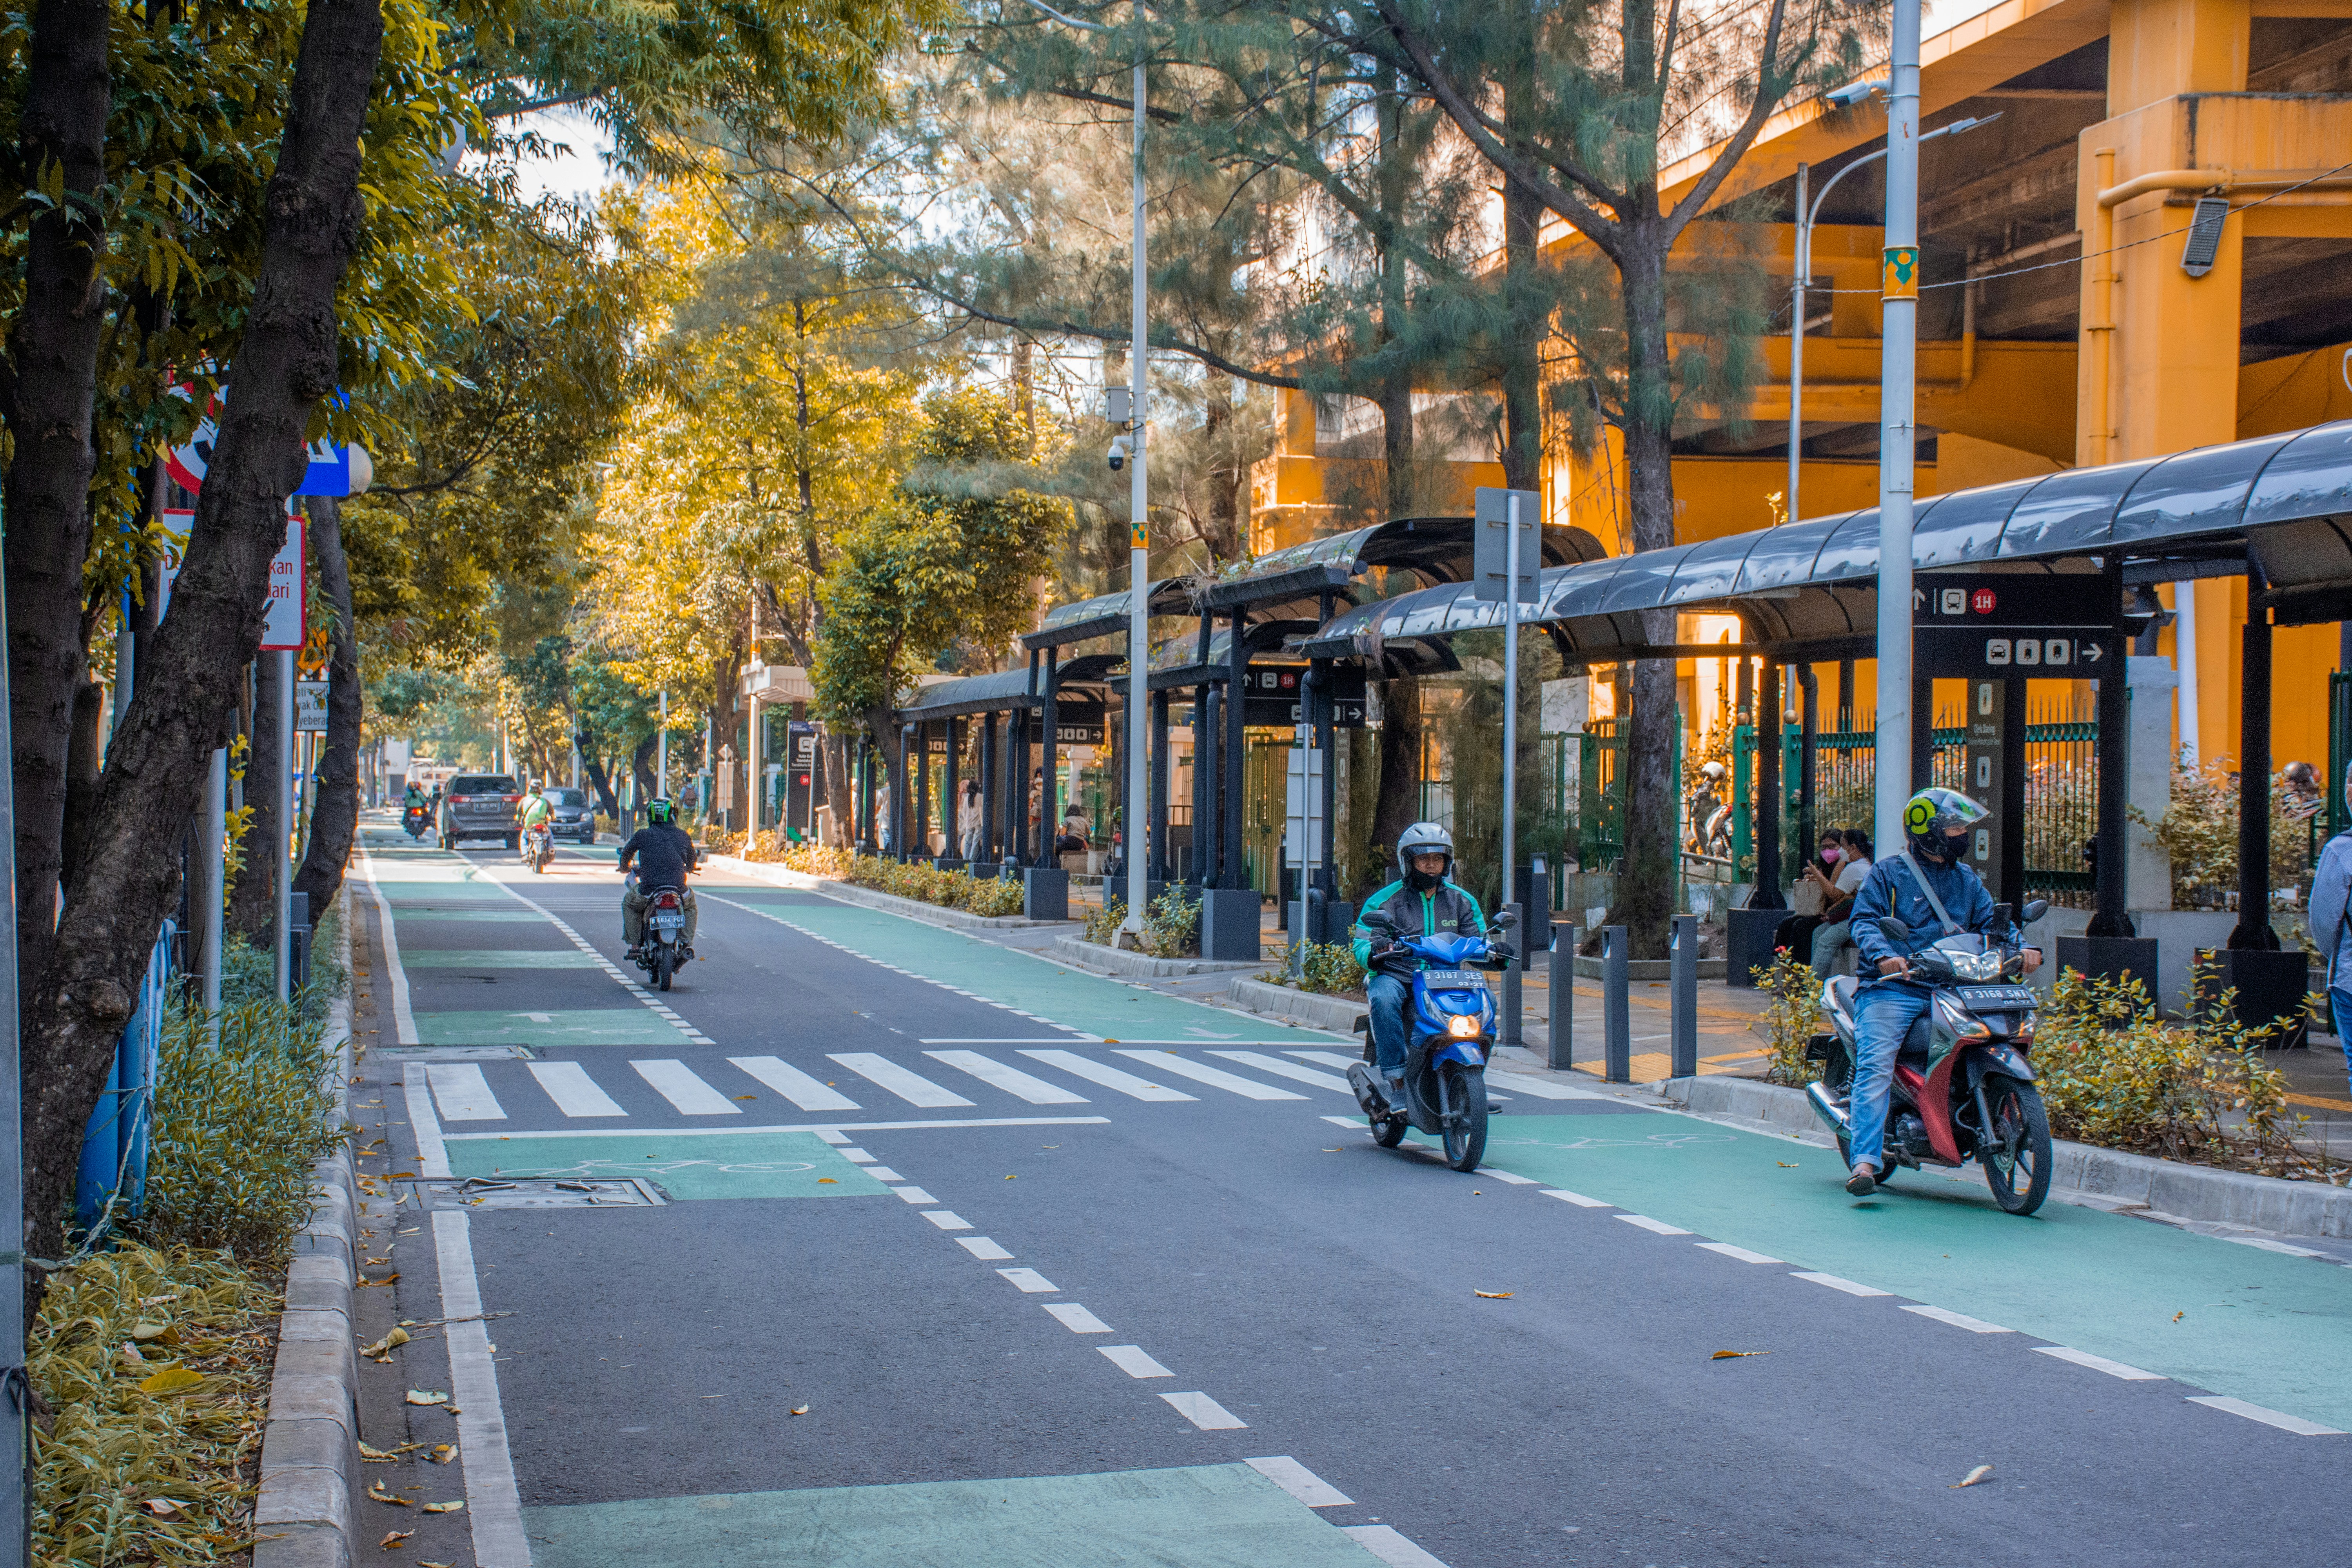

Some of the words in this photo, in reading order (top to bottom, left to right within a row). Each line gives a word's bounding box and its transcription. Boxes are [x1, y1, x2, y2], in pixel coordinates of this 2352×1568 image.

[1976, 595, 1991, 608] 1H
[1283, 676, 1293, 684] 1H
[1964, 991, 1973, 999] B
[1975, 990, 2004, 998] 3168
[2006, 989, 2027, 998] SNT
